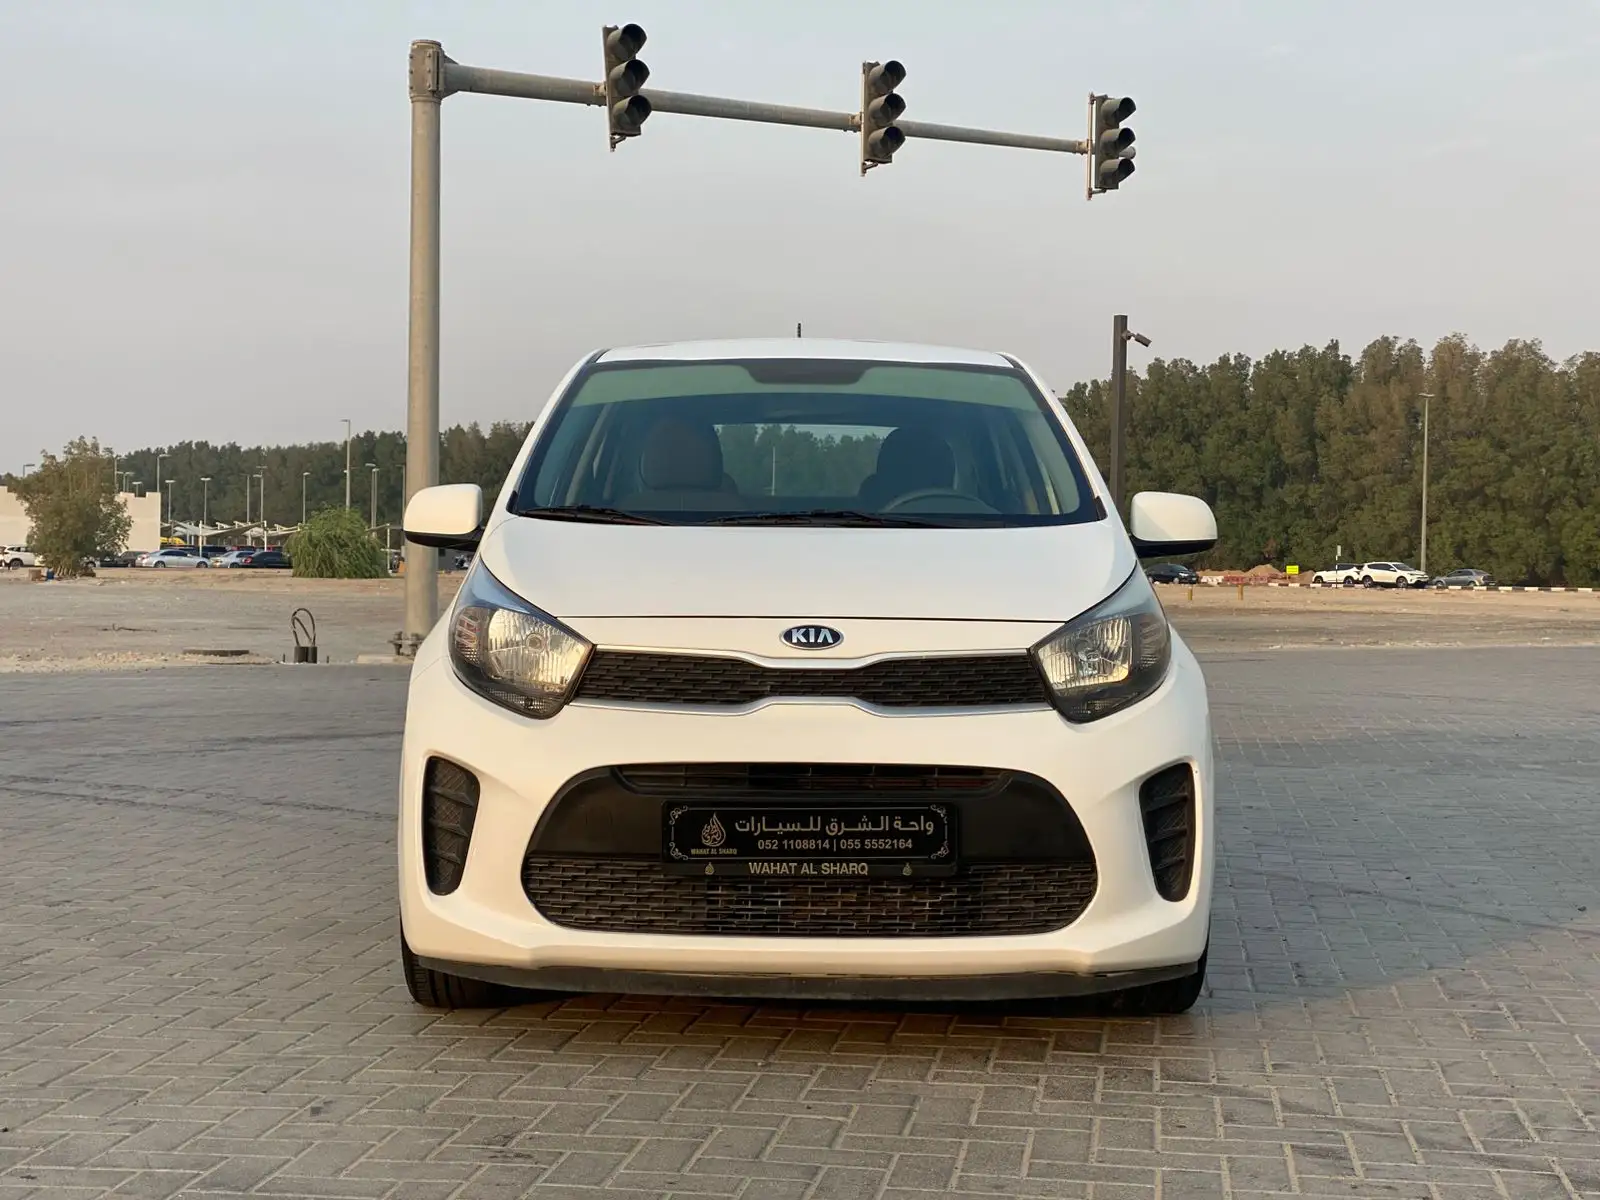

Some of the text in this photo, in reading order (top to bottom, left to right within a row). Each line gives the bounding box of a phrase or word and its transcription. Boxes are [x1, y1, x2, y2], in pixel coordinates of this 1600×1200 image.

[791, 628, 834, 644] KIA
[735, 815, 821, 836] للسيارات
[825, 815, 889, 836] الشرق
[893, 815, 934, 835] واحة
[757, 839, 779, 850] 052
[782, 839, 830, 850] 1108814
[840, 838, 861, 850] 055
[864, 838, 913, 850] 5552164
[748, 862, 869, 876] WAHAT AL SHARQ
